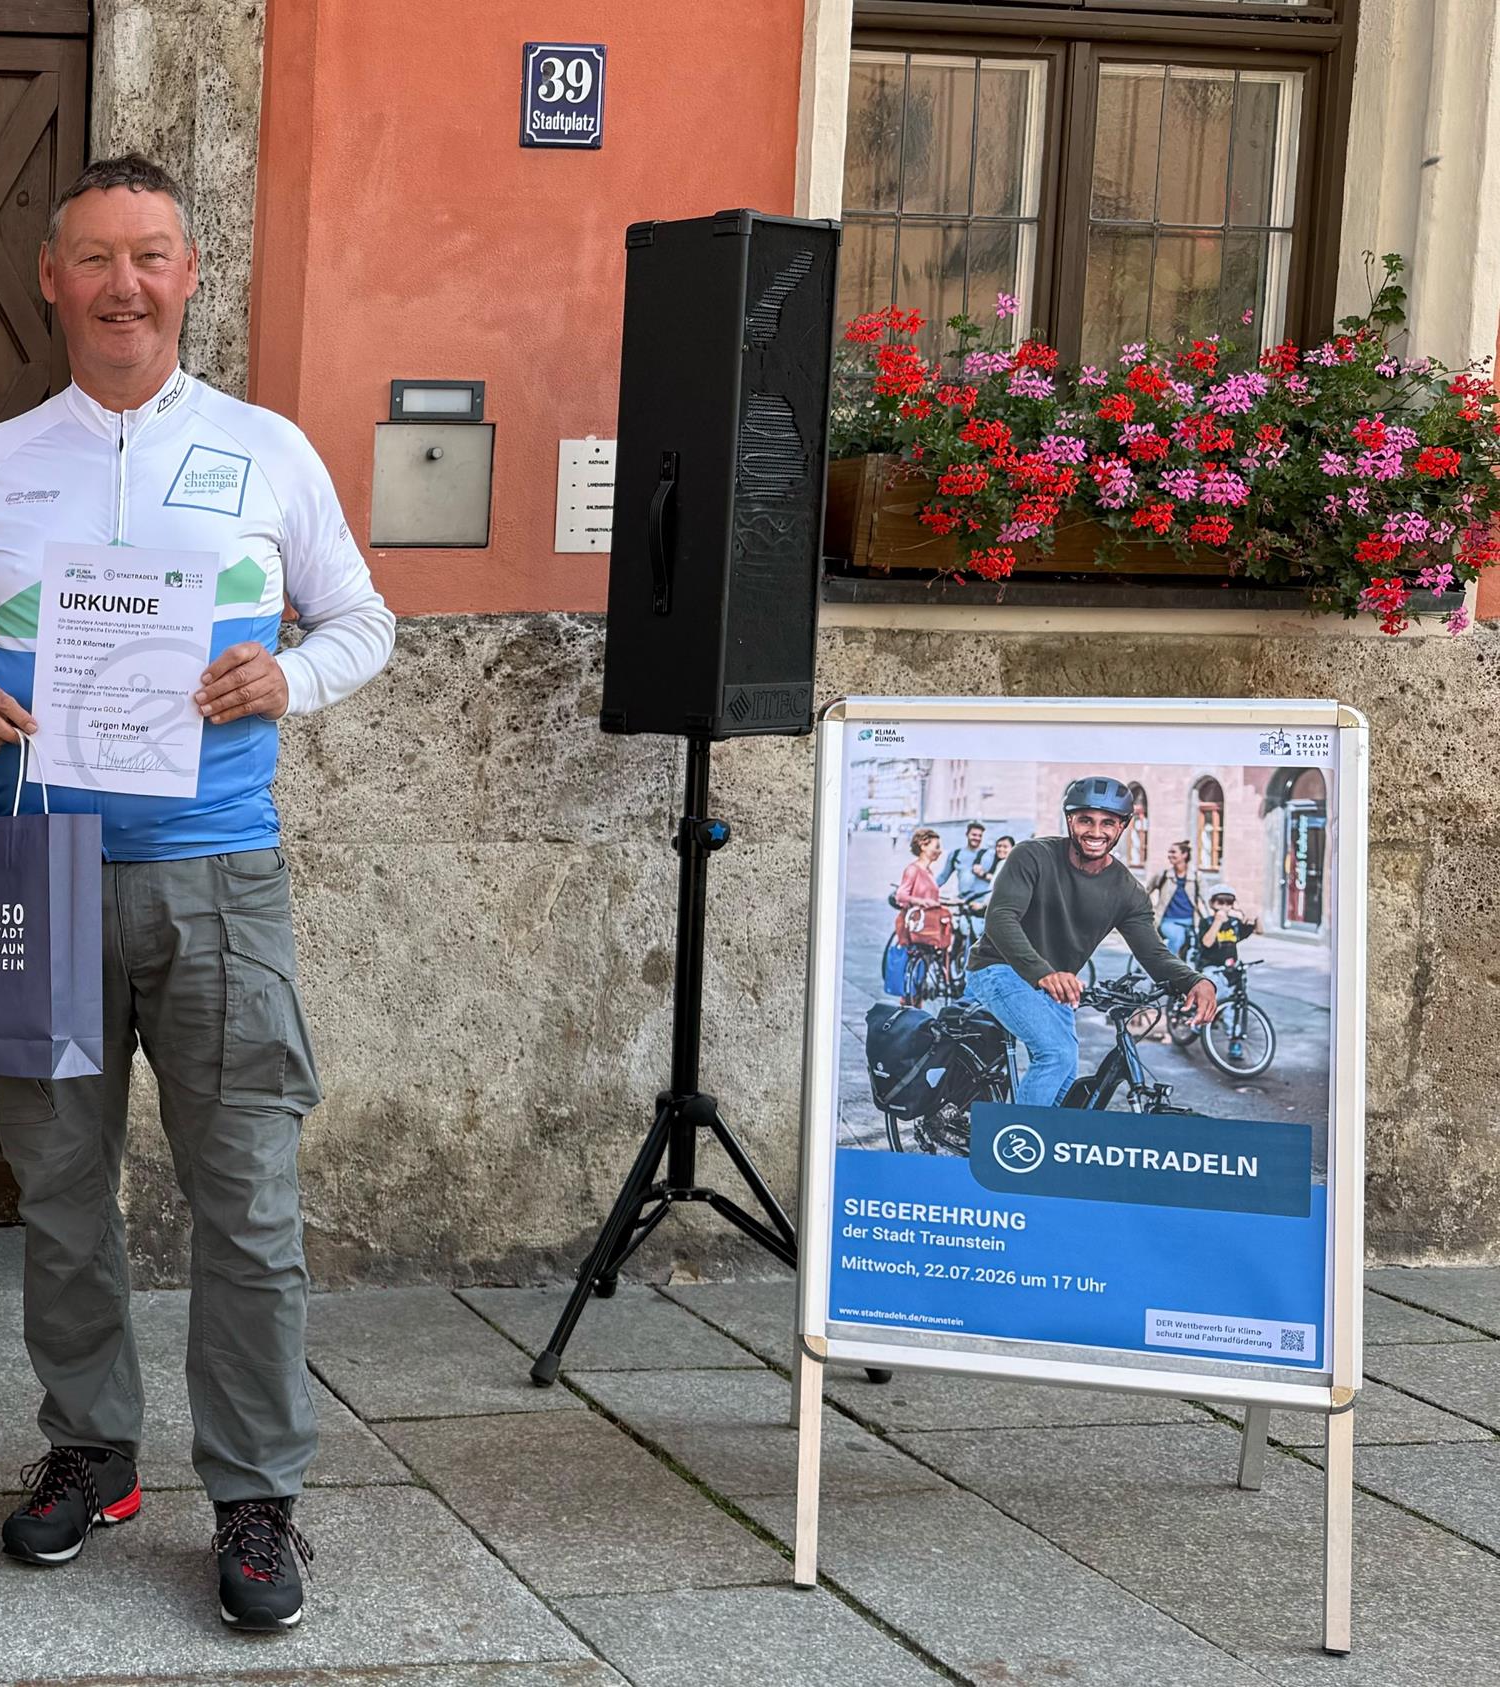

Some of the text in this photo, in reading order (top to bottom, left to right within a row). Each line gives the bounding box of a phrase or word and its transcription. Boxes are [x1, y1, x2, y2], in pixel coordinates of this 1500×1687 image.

[538, 57, 592, 103] 39
[532, 110, 595, 135] Stadtplatz
[184, 470, 238, 481] chiemsee
[184, 479, 238, 490] chiemgau
[116, 572, 159, 581] STADTRADELN
[59, 592, 160, 615] URKUNDE
[82, 640, 116, 649] Kilometer
[74, 668, 83, 676] kg
[103, 705, 123, 714] GOLD
[751, 688, 808, 721] ITEC
[88, 720, 149, 733] Jürgen Mayer
[1053, 1141, 1259, 1178] STADTRADELN
[844, 1198, 1027, 1231] SIEGEREHRUNG
[842, 1223, 1006, 1252] der Stadt Traunstein
[841, 1255, 1108, 1294] Mittwoch, 22.07.2026 um 17 Uhr
[838, 1307, 964, 1327] www.stadtradeln.de/traunstein
[1156, 1319, 1173, 1328] DER
[1174, 1320, 1223, 1333] Wettbewerb
[1224, 1325, 1236, 1334] für
[1155, 1330, 1273, 1349] schutz und Fahrradförderung
